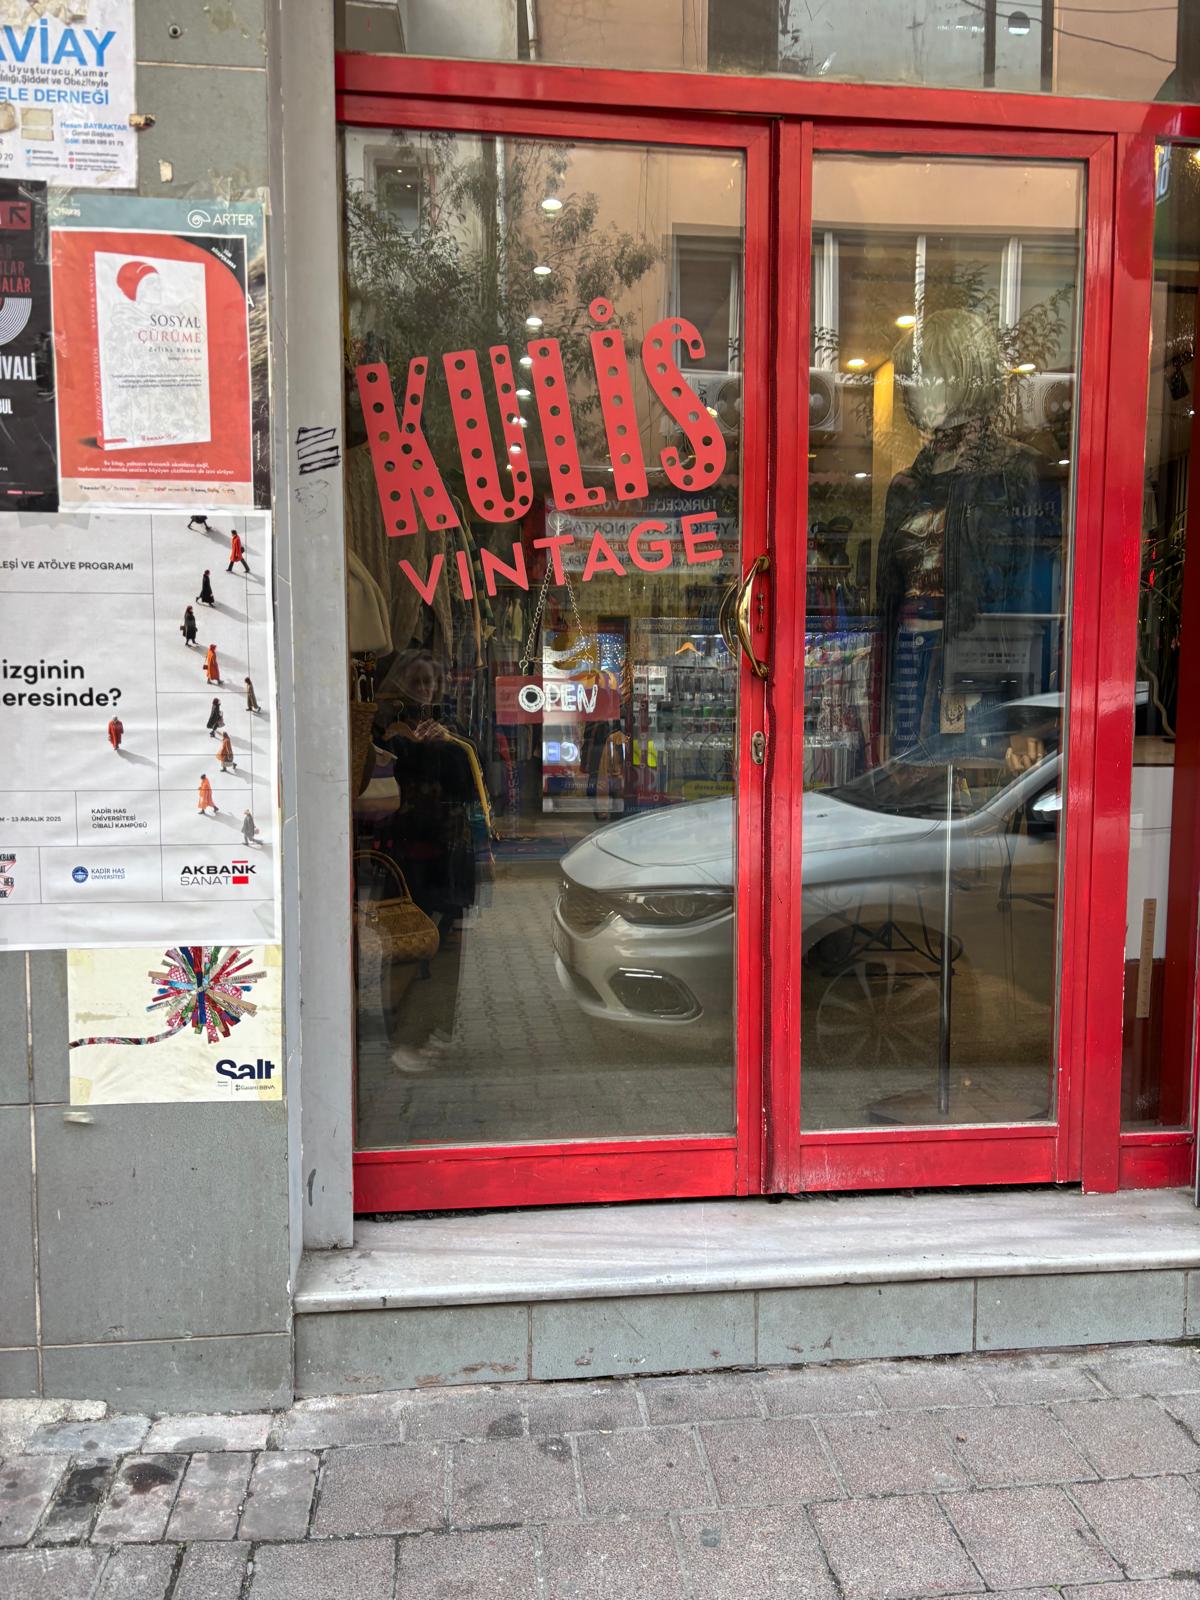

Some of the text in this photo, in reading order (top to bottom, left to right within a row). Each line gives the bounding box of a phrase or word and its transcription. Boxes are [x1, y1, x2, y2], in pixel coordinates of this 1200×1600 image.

[0, 18, 117, 67] VİAY
[63, 77, 109, 88] Obeziteyle
[34, 88, 109, 105] DERNEĞİ
[83, 122, 128, 131] BAYRAKTAR
[213, 213, 255, 226] ARTER
[150, 313, 201, 328] SOSYAL
[137, 328, 202, 344] ÇÜRÜME
[356, 297, 727, 537] KULİS
[21, 561, 35, 569] VE
[38, 559, 76, 570] ATÖLYE
[79, 561, 134, 570] PROGRAMI
[399, 511, 724, 606] VINTAGE
[3, 659, 85, 685] izginin
[2, 687, 122, 707] eresinde?
[518, 683, 599, 714] OPEN
[91, 806, 112, 814] KADİR
[91, 813, 136, 821] ÜNİVERSİTESİ
[181, 864, 256, 876] AKBANK
[180, 875, 231, 886] SANAT
[216, 1058, 275, 1079] Salt
